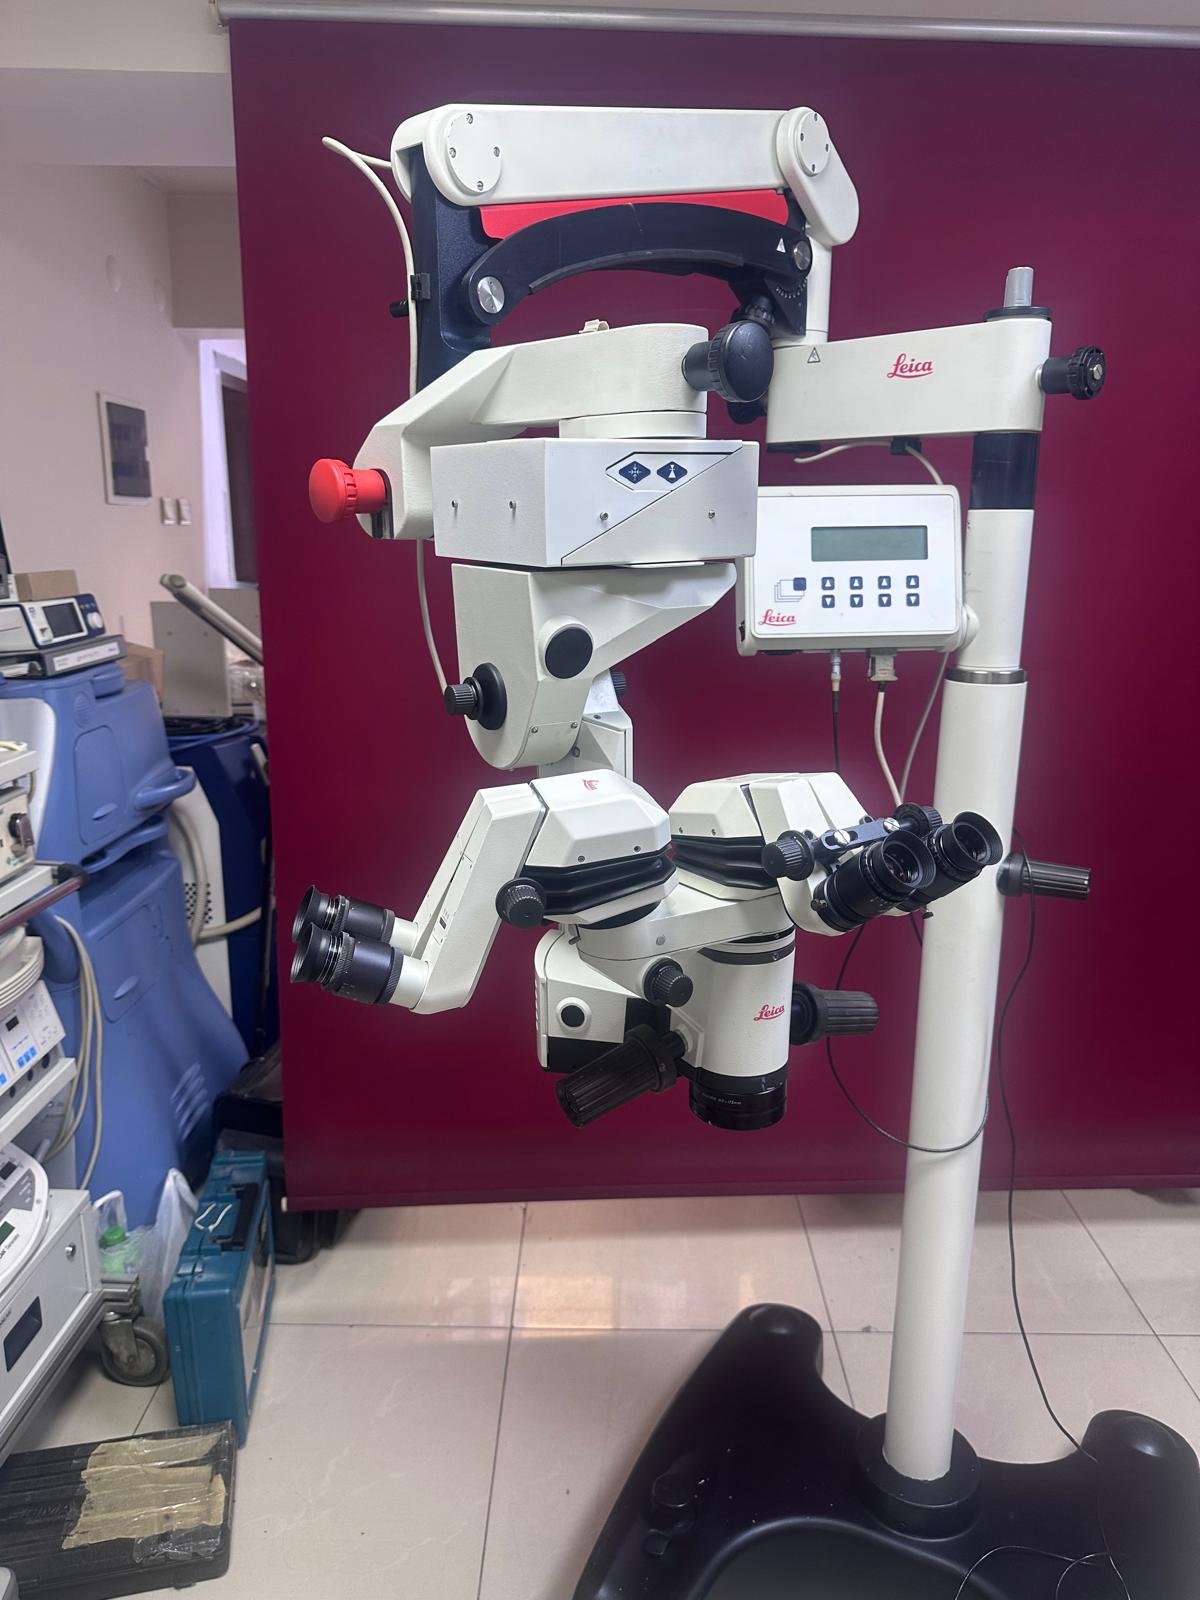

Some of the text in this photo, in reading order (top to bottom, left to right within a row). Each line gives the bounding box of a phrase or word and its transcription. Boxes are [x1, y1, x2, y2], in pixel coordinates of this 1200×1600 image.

[887, 353, 932, 379] Leica
[760, 609, 795, 625] Leica
[754, 1005, 785, 1021] Leica
